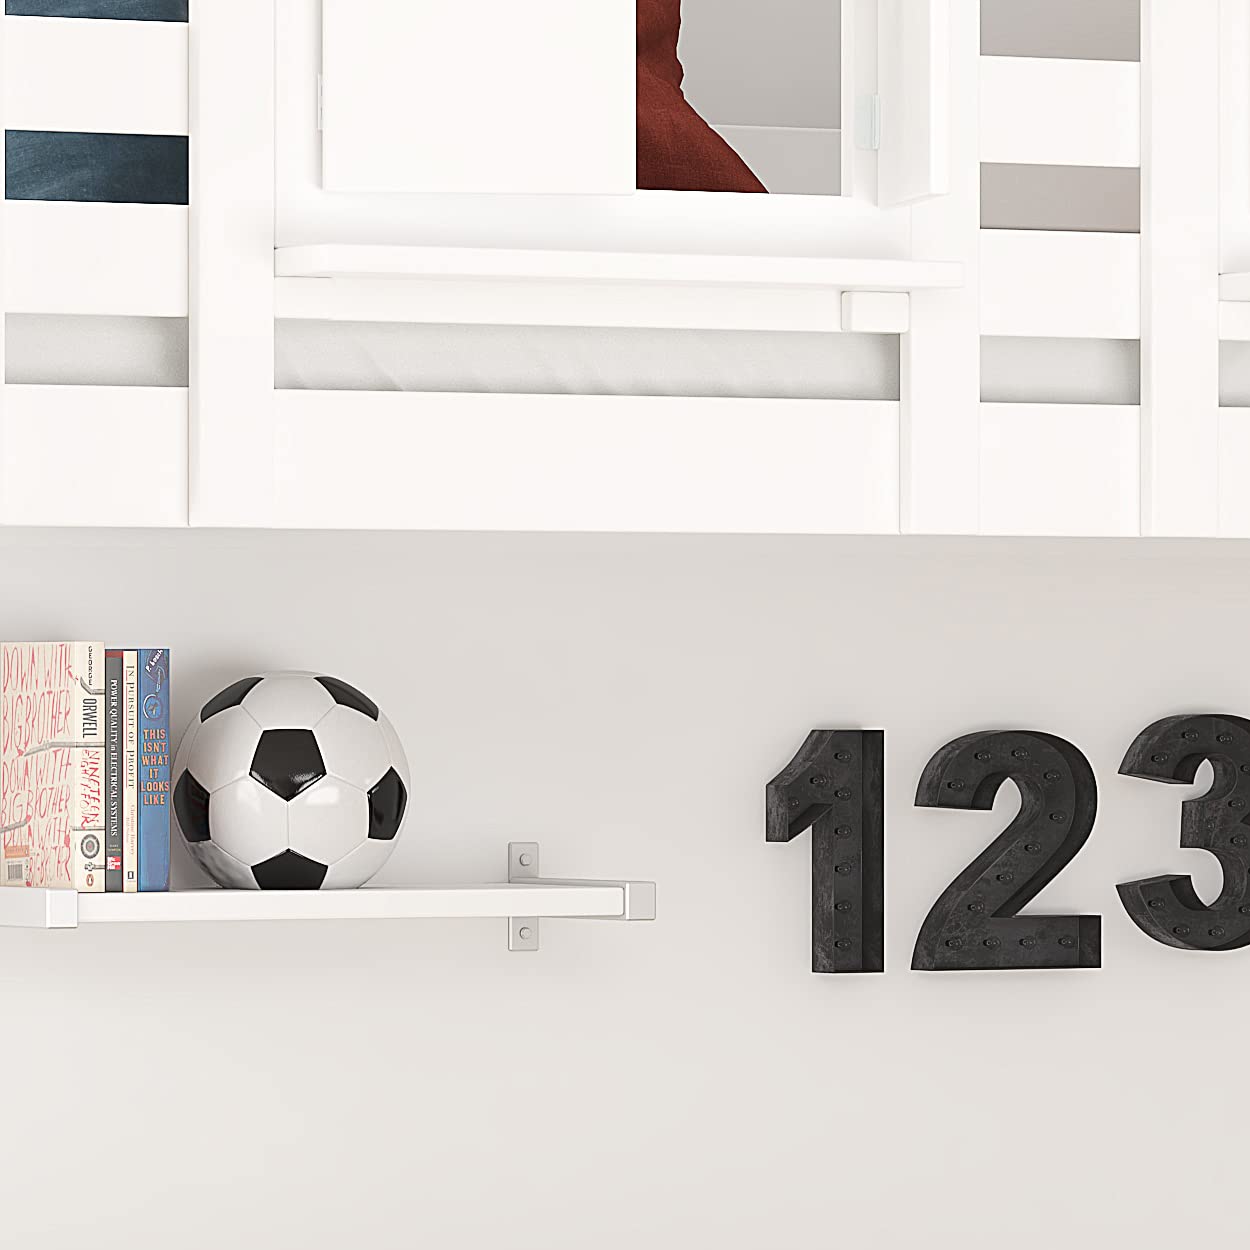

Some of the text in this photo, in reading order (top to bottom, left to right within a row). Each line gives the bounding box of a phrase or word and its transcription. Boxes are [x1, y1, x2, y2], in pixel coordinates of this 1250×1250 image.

[3, 644, 39, 693] DOWN
[82, 698, 97, 739] ORWELL
[109, 708, 118, 744] QUALITY
[126, 665, 135, 790] IN PURSUIT OF PROFIT
[143, 729, 166, 739] THIS
[142, 754, 169, 765] WHAT
[143, 741, 166, 753] ISN'T
[88, 750, 101, 825] NINETEEN
[110, 752, 118, 800] ELECTRICAL
[140, 781, 170, 792] LOOKS
[149, 768, 159, 779] IT
[143, 794, 165, 805] LIKE
[110, 801, 118, 837] SYSTEMS
